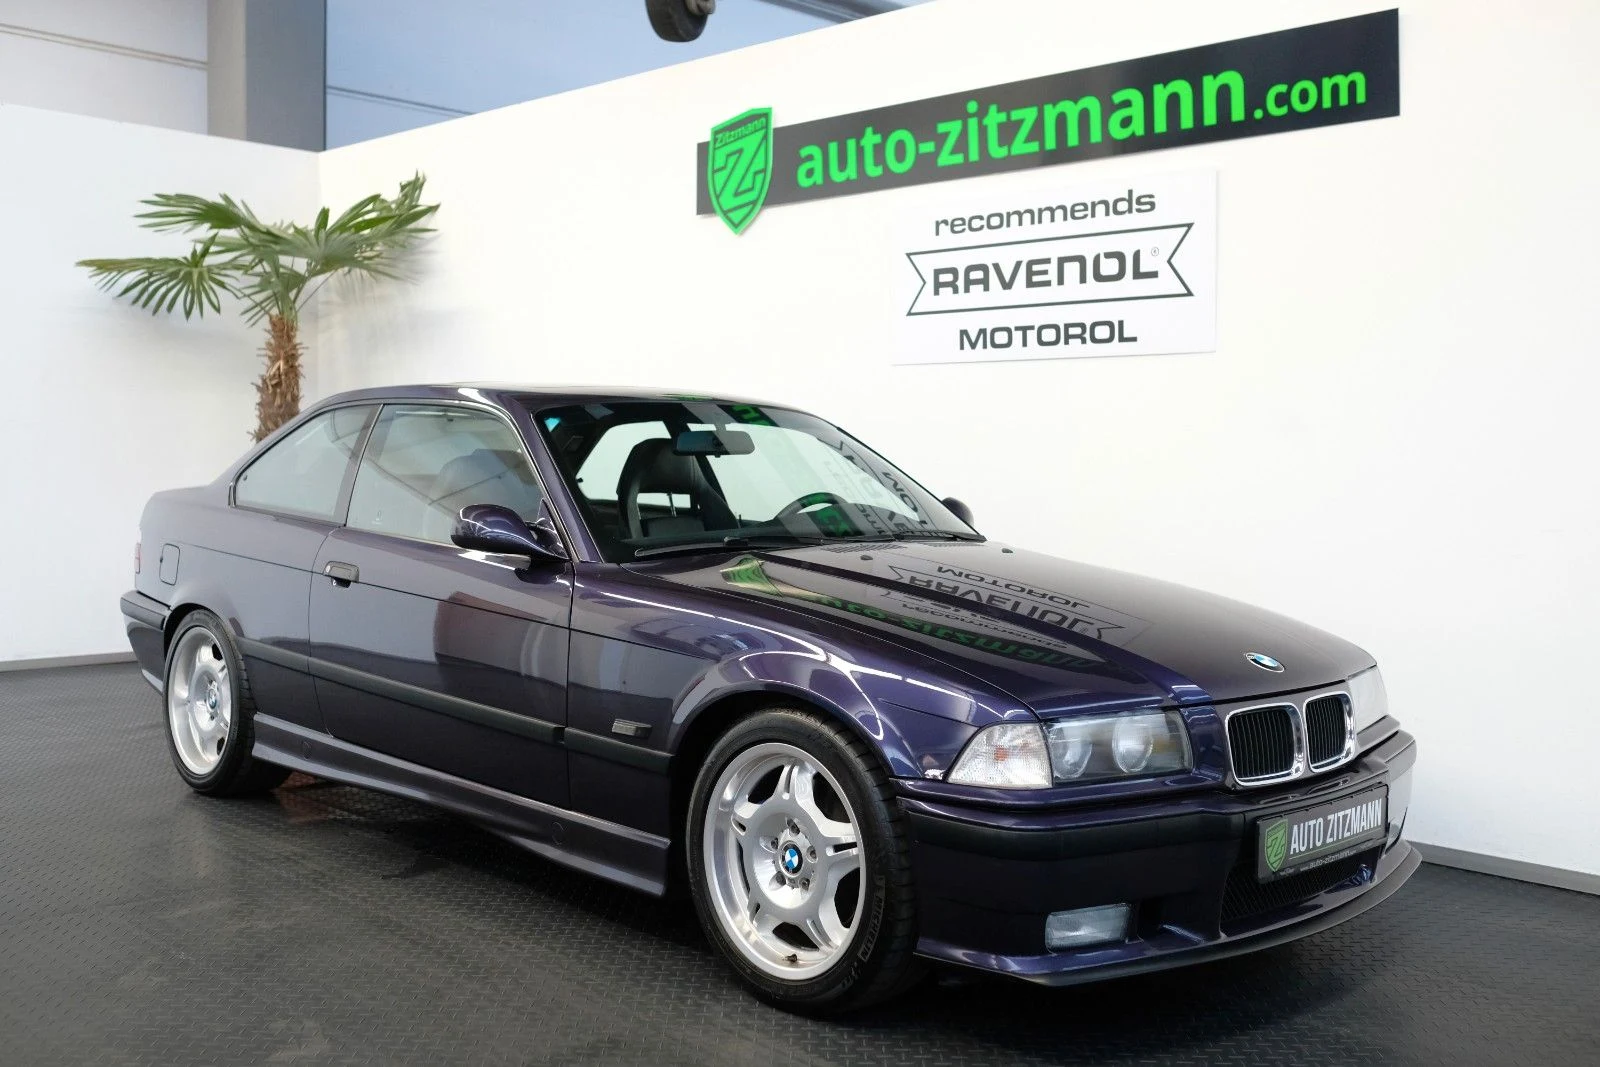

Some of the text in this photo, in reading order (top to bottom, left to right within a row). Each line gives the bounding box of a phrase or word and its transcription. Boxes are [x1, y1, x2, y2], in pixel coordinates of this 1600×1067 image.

[715, 116, 766, 146] Zitzmann
[796, 69, 1367, 189] auto-zitzmann.com
[935, 189, 1156, 237] recommends
[933, 249, 1160, 296] RAVENOL
[960, 319, 1138, 351] MOTOROL
[1290, 798, 1382, 855] AUTO ZITZMANN
